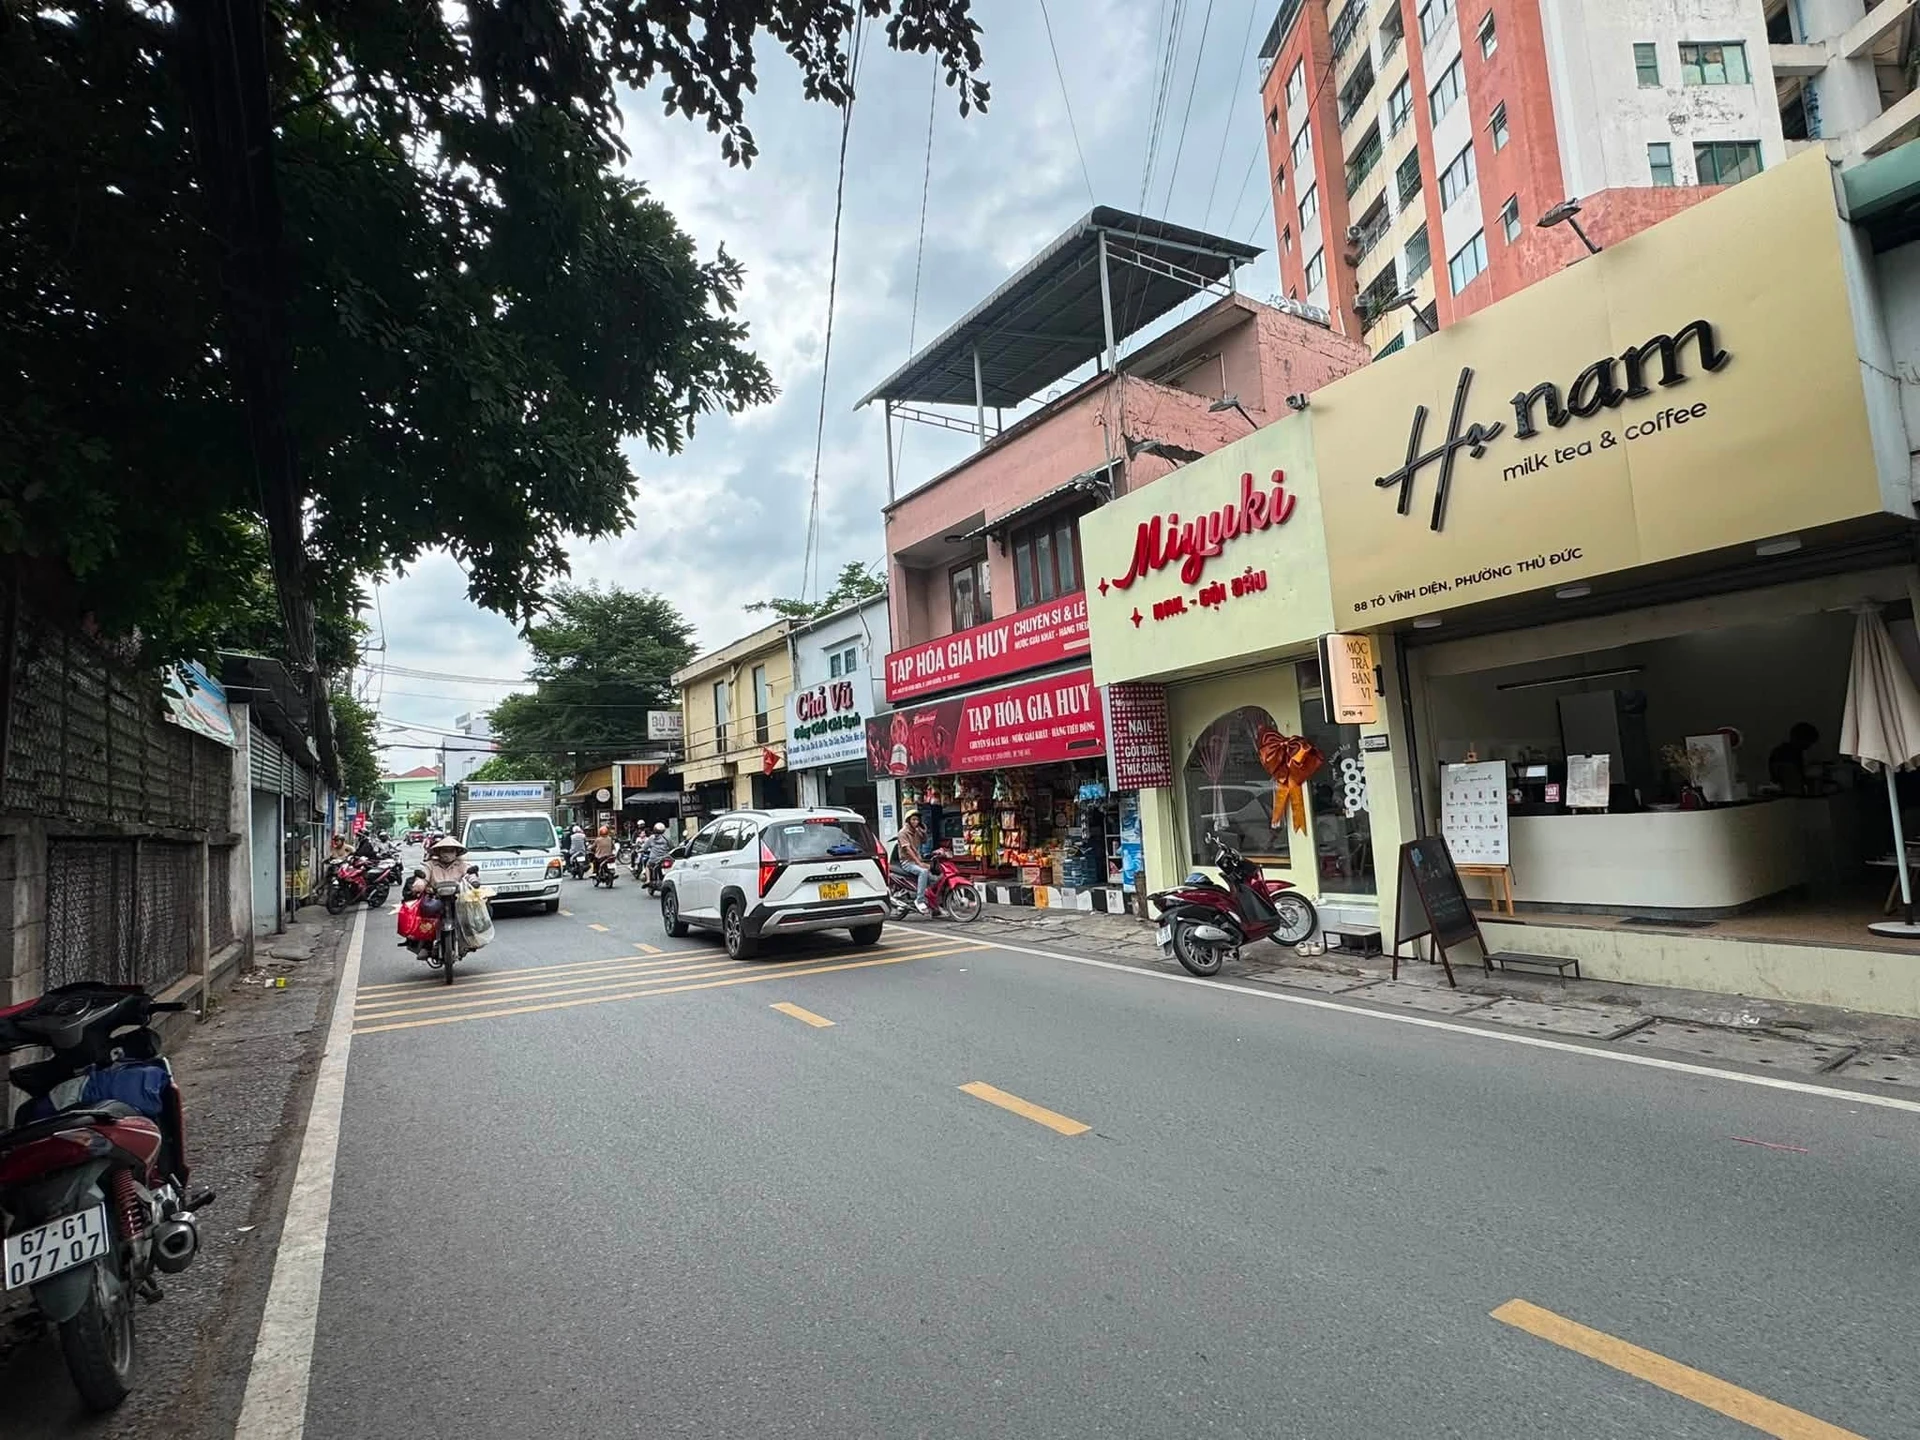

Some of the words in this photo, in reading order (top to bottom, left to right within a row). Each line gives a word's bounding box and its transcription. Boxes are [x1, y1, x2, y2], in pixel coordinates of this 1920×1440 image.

[1509, 319, 1729, 439] nam
[1503, 454, 1548, 482] milk
[1556, 441, 1592, 463] tea
[1600, 431, 1618, 449] &
[1625, 402, 1708, 442] coffee
[1112, 469, 1296, 590] Miyuki
[1354, 601, 1368, 612] 88
[1370, 593, 1386, 609] TÔ
[1389, 587, 1416, 603] VĨNH
[1419, 578, 1452, 597] DIỆN,
[1455, 564, 1513, 588] PHƯỜNG
[1517, 555, 1545, 575] THỦ
[1550, 547, 1583, 567] ĐỨC
[1013, 612, 1050, 637] CHUYÊN
[1064, 605, 1072, 621] &
[890, 657, 913, 685] TẠP
[916, 644, 945, 677] HÓA
[948, 638, 973, 668] GIA
[976, 626, 1009, 661] HUY
[1346, 641, 1368, 655] MỘC
[1350, 656, 1369, 671] TRÀ
[796, 685, 827, 721] Chả
[829, 681, 854, 712] Vũ
[967, 707, 992, 736] TẠP
[995, 696, 1023, 730] HÓA
[1027, 692, 1053, 722] GIA
[1056, 683, 1091, 716] HUY
[1128, 719, 1153, 734] NAIL
[11, 1233, 100, 1285] 077.07
[21, 1213, 87, 1256] 67-G1
